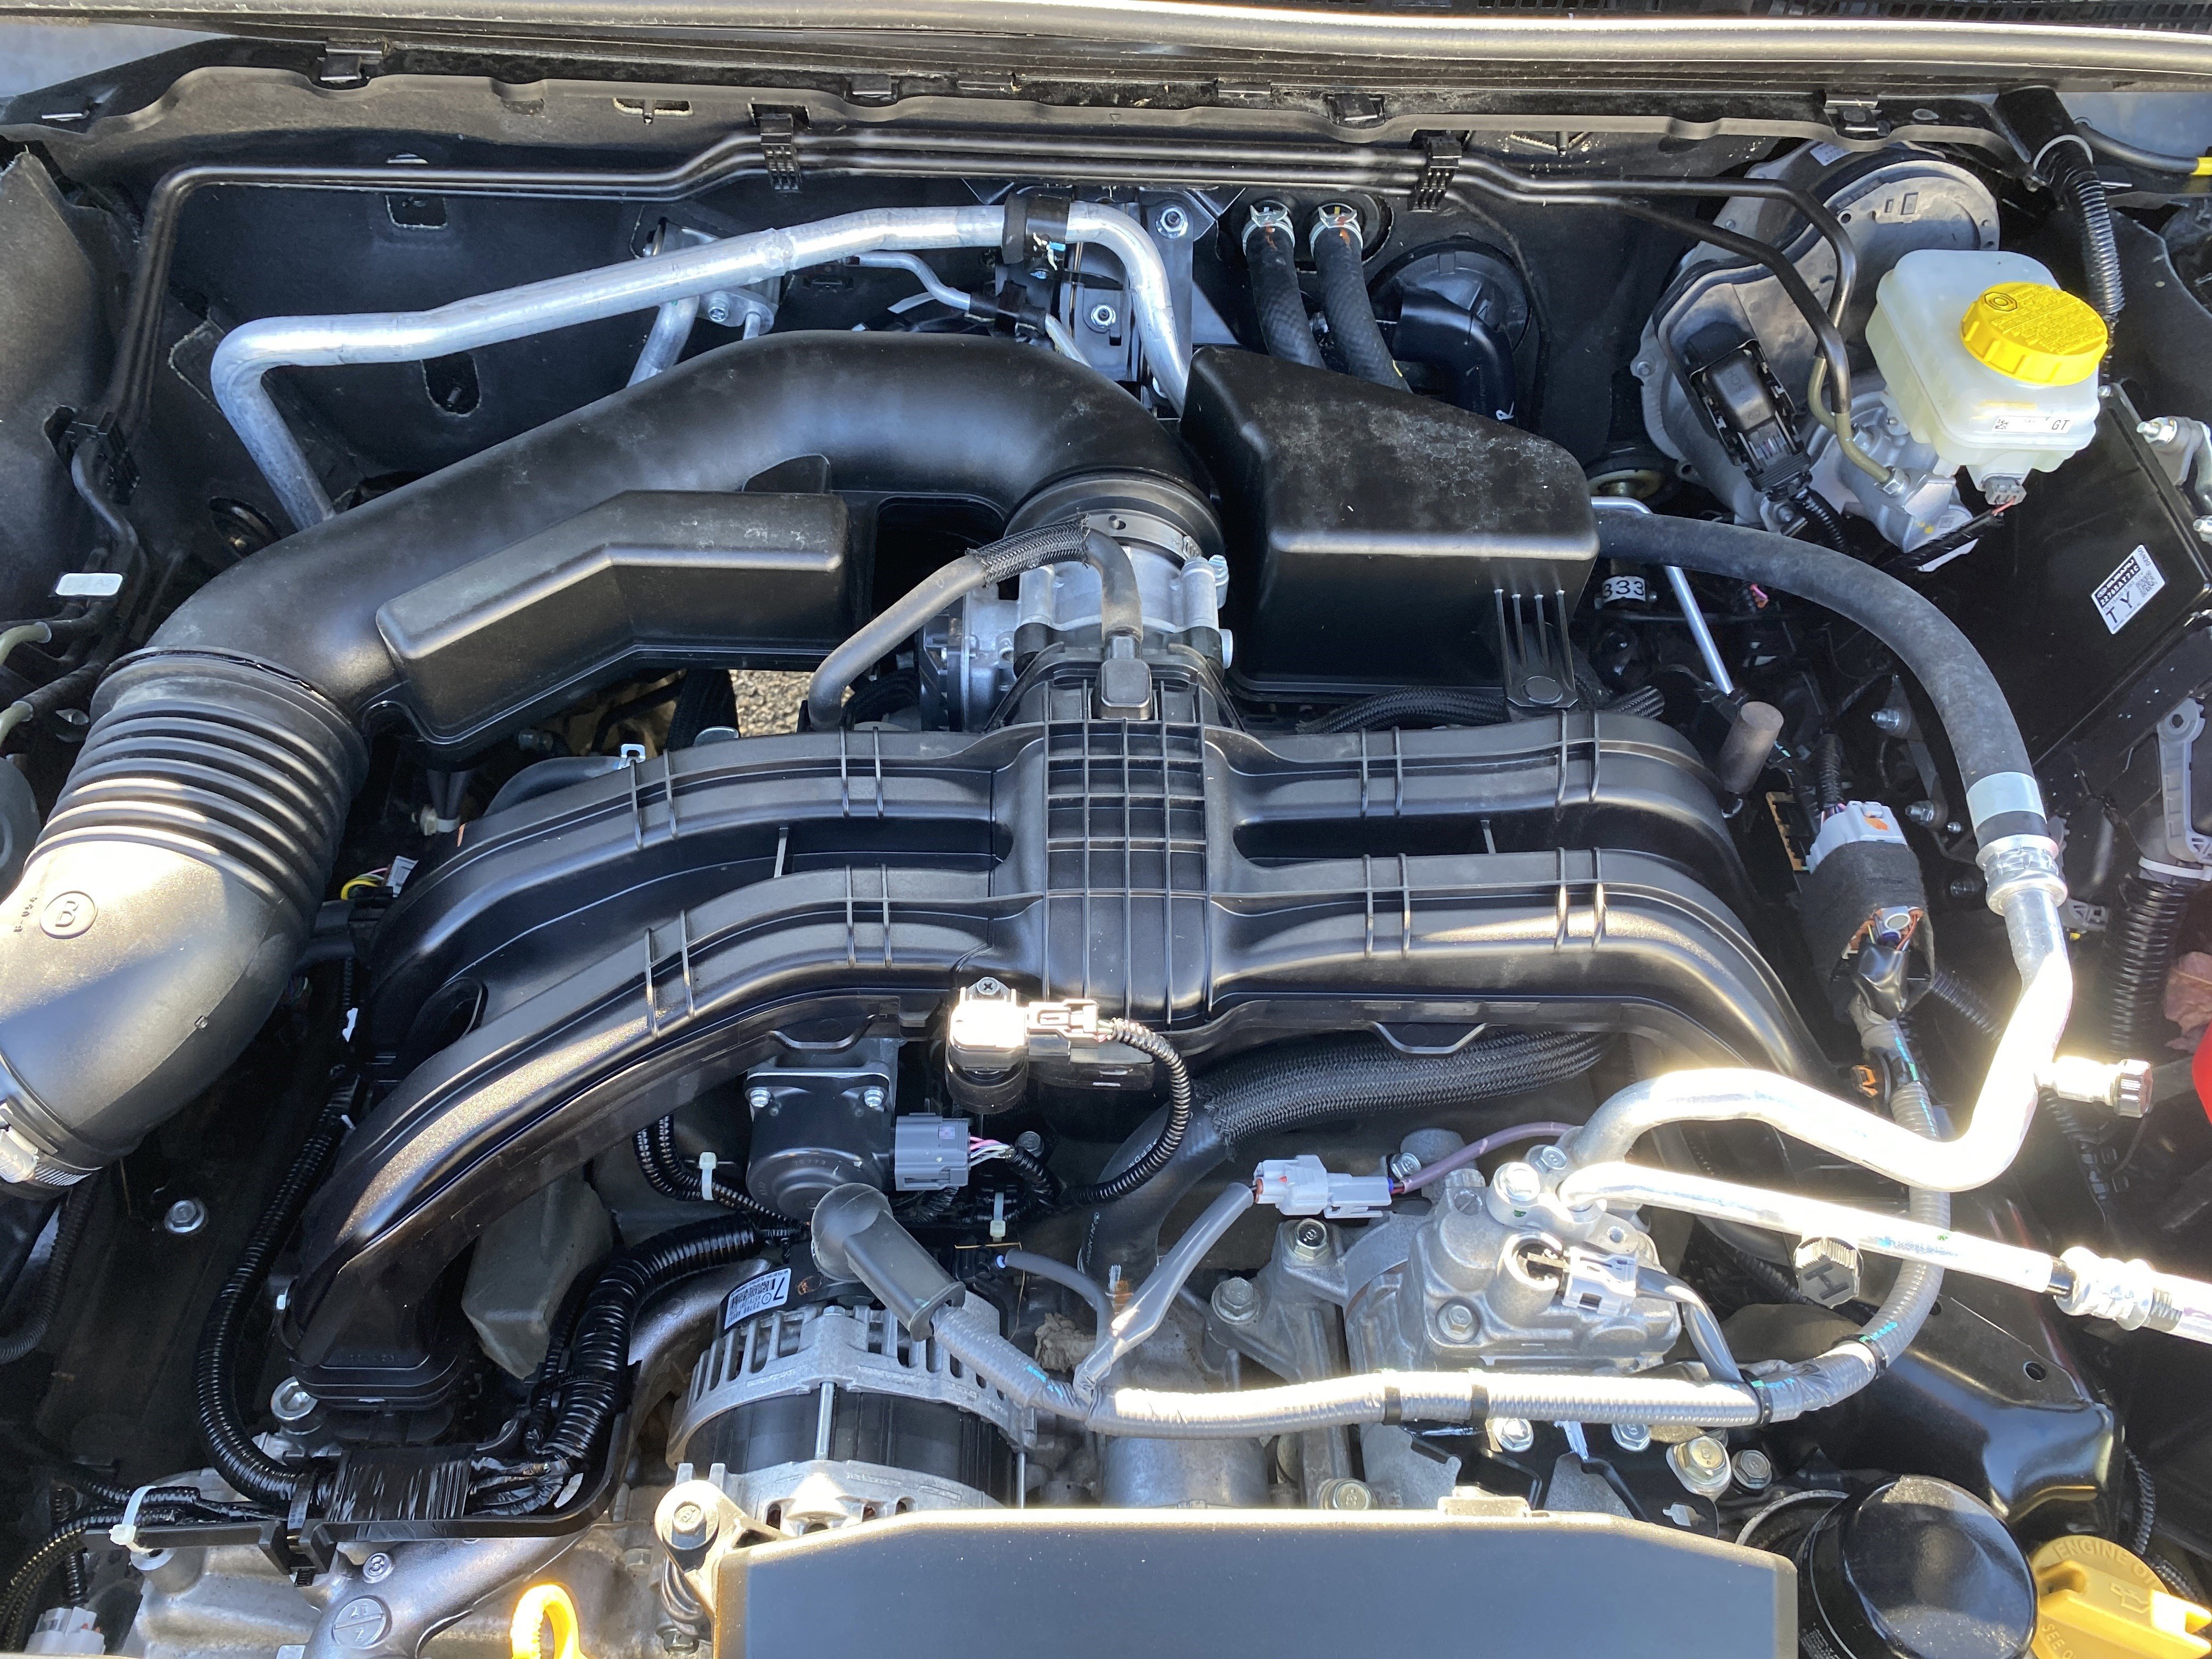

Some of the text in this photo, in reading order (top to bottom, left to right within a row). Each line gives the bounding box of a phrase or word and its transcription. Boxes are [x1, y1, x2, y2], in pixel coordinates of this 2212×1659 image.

[2052, 420, 2070, 430] GT
[2137, 547, 2151, 567] DENSO
[2106, 558, 2134, 589] SUBARU
[55, 900, 79, 927] B
[773, 1277, 785, 1301] 7
[1803, 1262, 1849, 1300] H
[368, 1555, 385, 1575] 3
[2053, 1538, 2130, 1565] ENGINE
[2041, 1623, 2065, 1650] SEE
